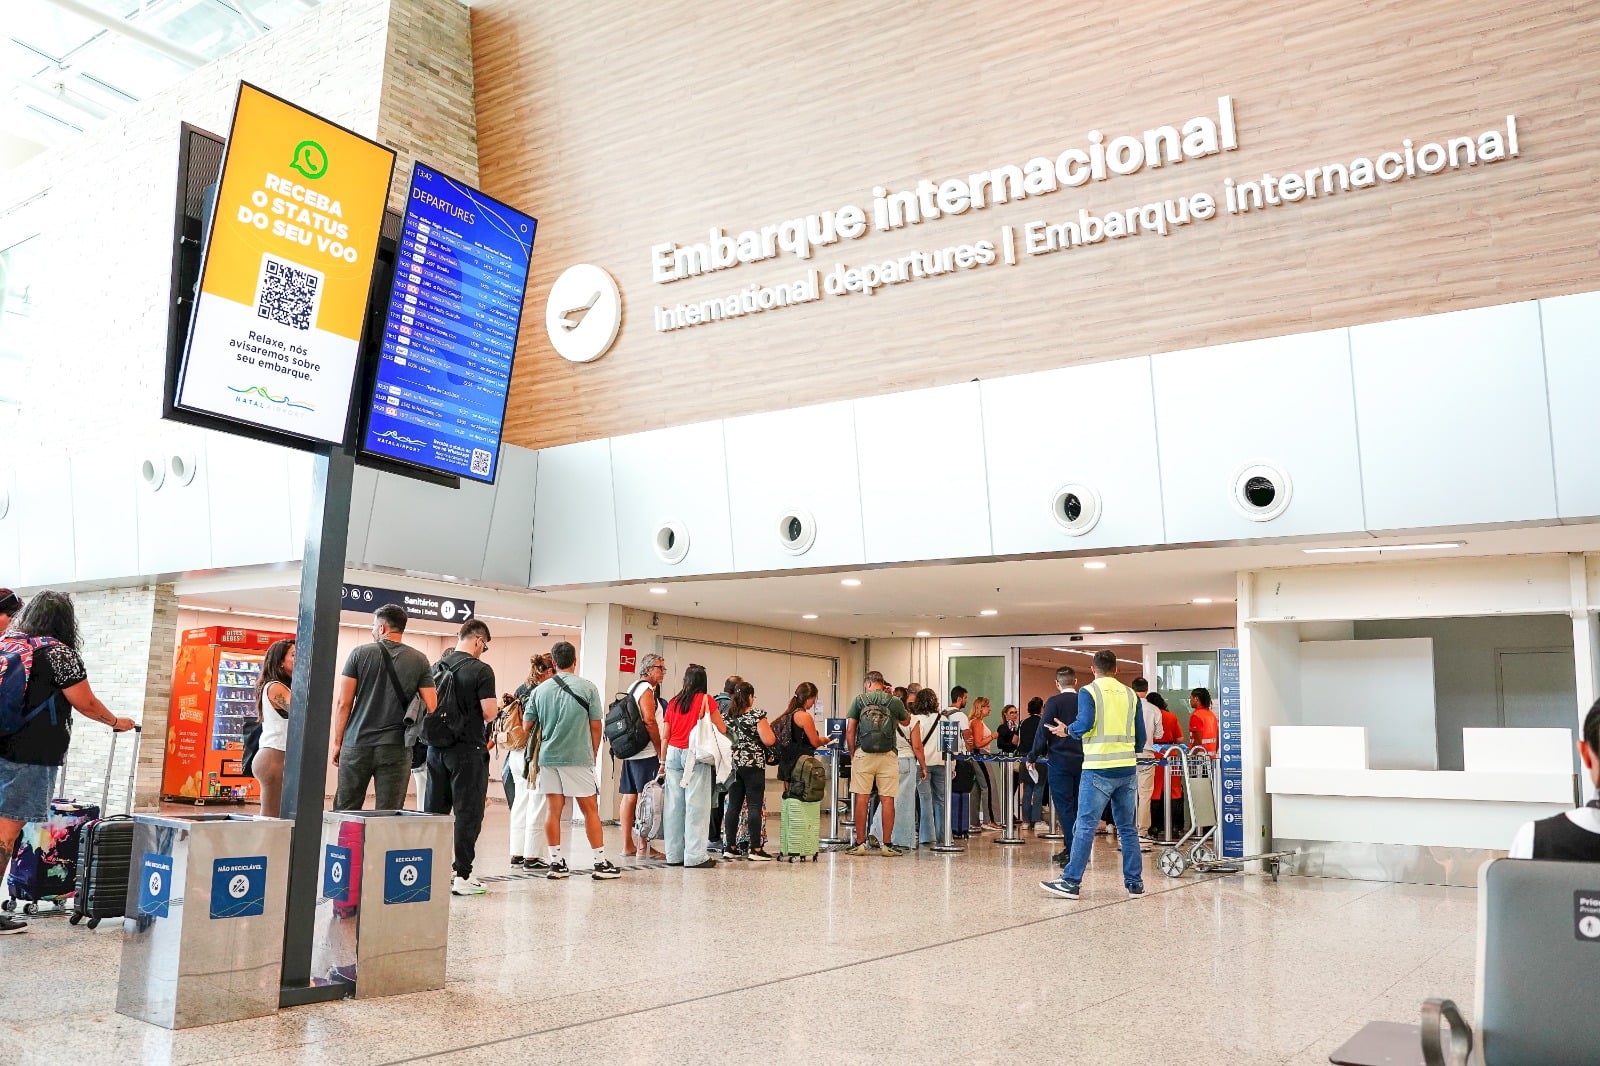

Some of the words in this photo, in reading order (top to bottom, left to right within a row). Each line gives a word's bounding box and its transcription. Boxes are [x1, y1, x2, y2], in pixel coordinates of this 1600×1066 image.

[416, 168, 433, 182] 13:42
[651, 205, 867, 284] Embarque
[872, 95, 1238, 231] internacional
[265, 172, 342, 218] RECEBA
[412, 187, 476, 225] DEPARTURES
[252, 190, 268, 208] O
[271, 197, 349, 240] STATUS
[655, 269, 820, 332] International
[824, 240, 995, 296] departures
[1024, 192, 1216, 256] Embarque
[1224, 114, 1519, 214] internacional
[237, 205, 269, 230] DO
[272, 219, 313, 246] SEU
[316, 234, 358, 263] VOO
[229, 339, 289, 363] avisaremos
[292, 357, 320, 371] sobre
[248, 330, 287, 352] Relaxe,
[289, 344, 308, 356] nós
[236, 353, 255, 364] seu
[258, 360, 313, 381] embarque.
[235, 396, 264, 409] NATAL
[404, 596, 439, 608] Sanitários
